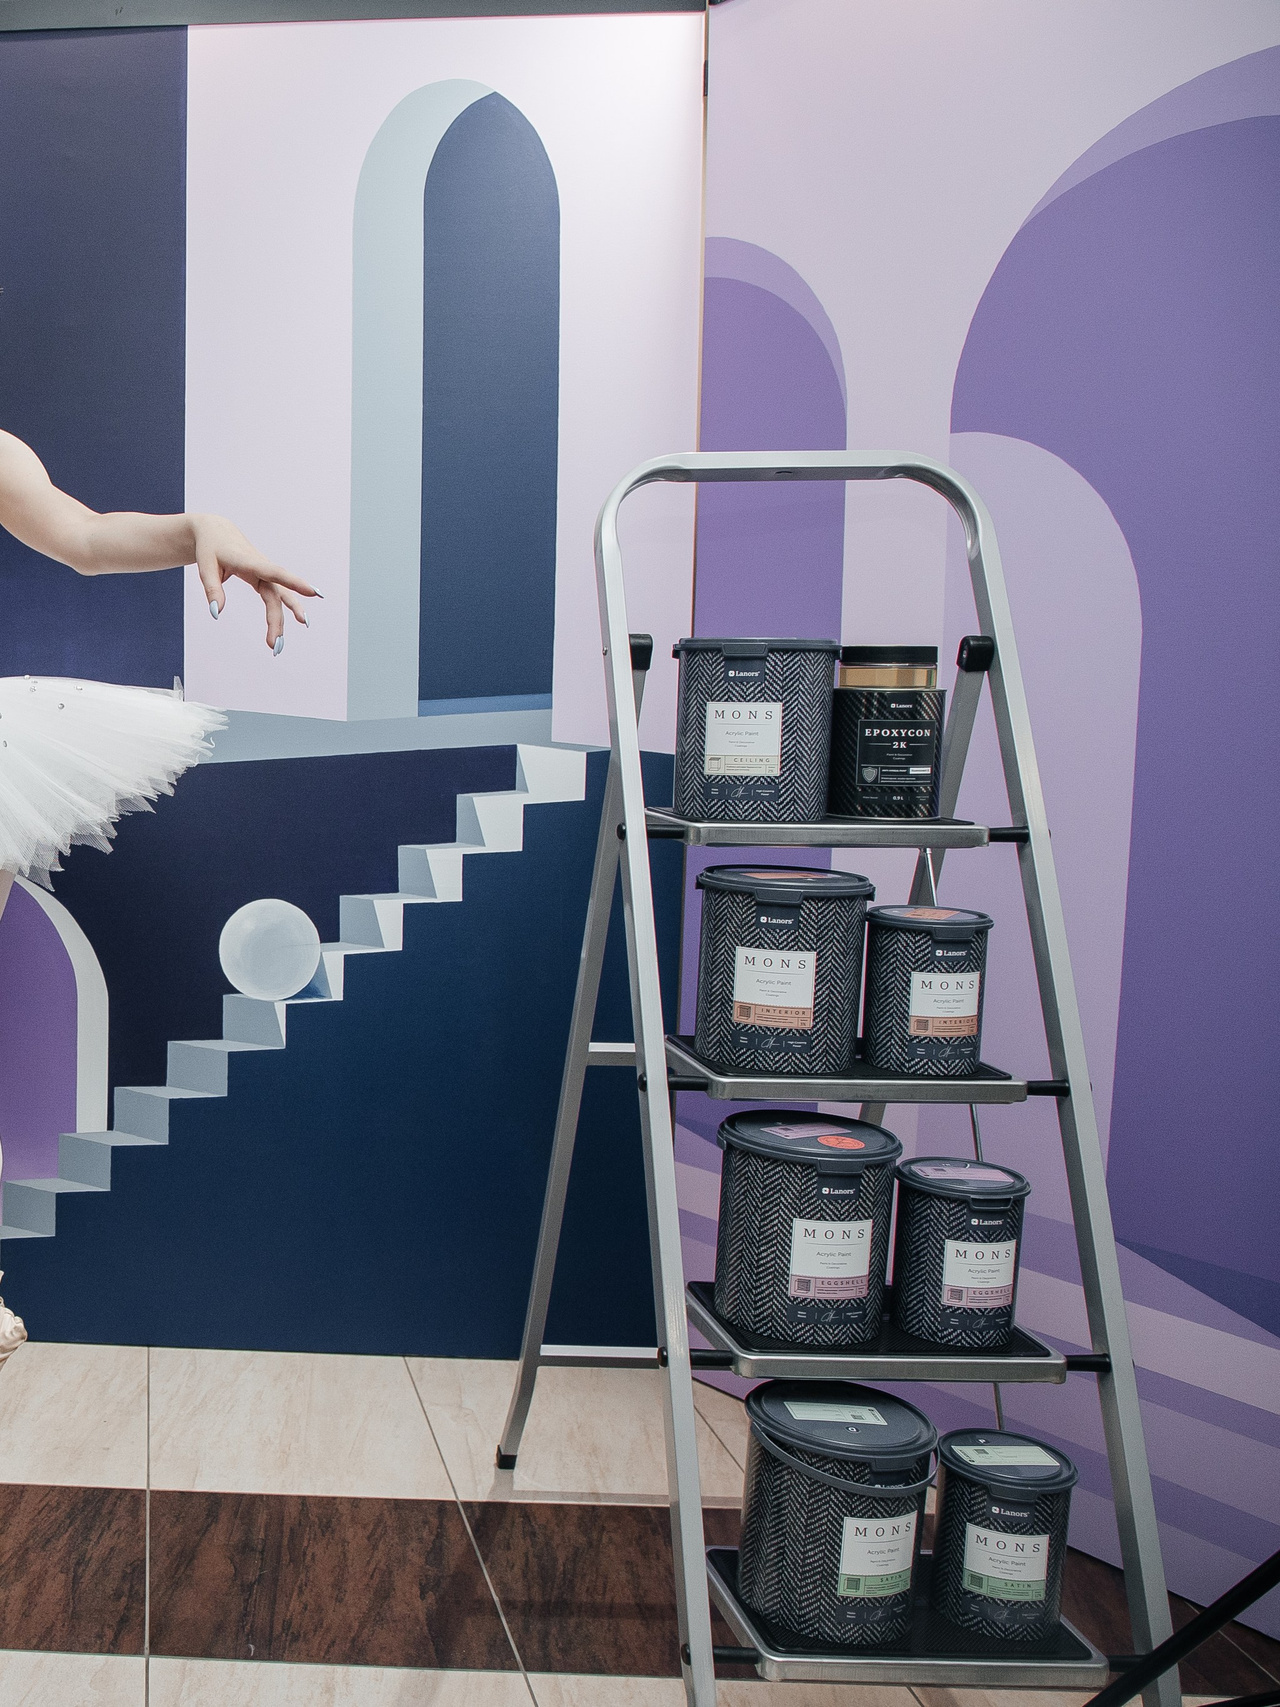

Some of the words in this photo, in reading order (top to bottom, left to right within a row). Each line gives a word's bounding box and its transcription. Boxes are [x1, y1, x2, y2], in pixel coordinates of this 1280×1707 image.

[714, 710, 773, 720] MONS
[864, 728, 931, 737] EPOXYCON
[744, 956, 806, 970] MONS
[920, 980, 975, 990] MONS
[761, 1008, 806, 1016] INTERIOR
[803, 1228, 865, 1240] MONS
[955, 1248, 1011, 1260] MONS
[854, 1521, 912, 1537] MONS
[975, 1534, 1041, 1553] MONS
